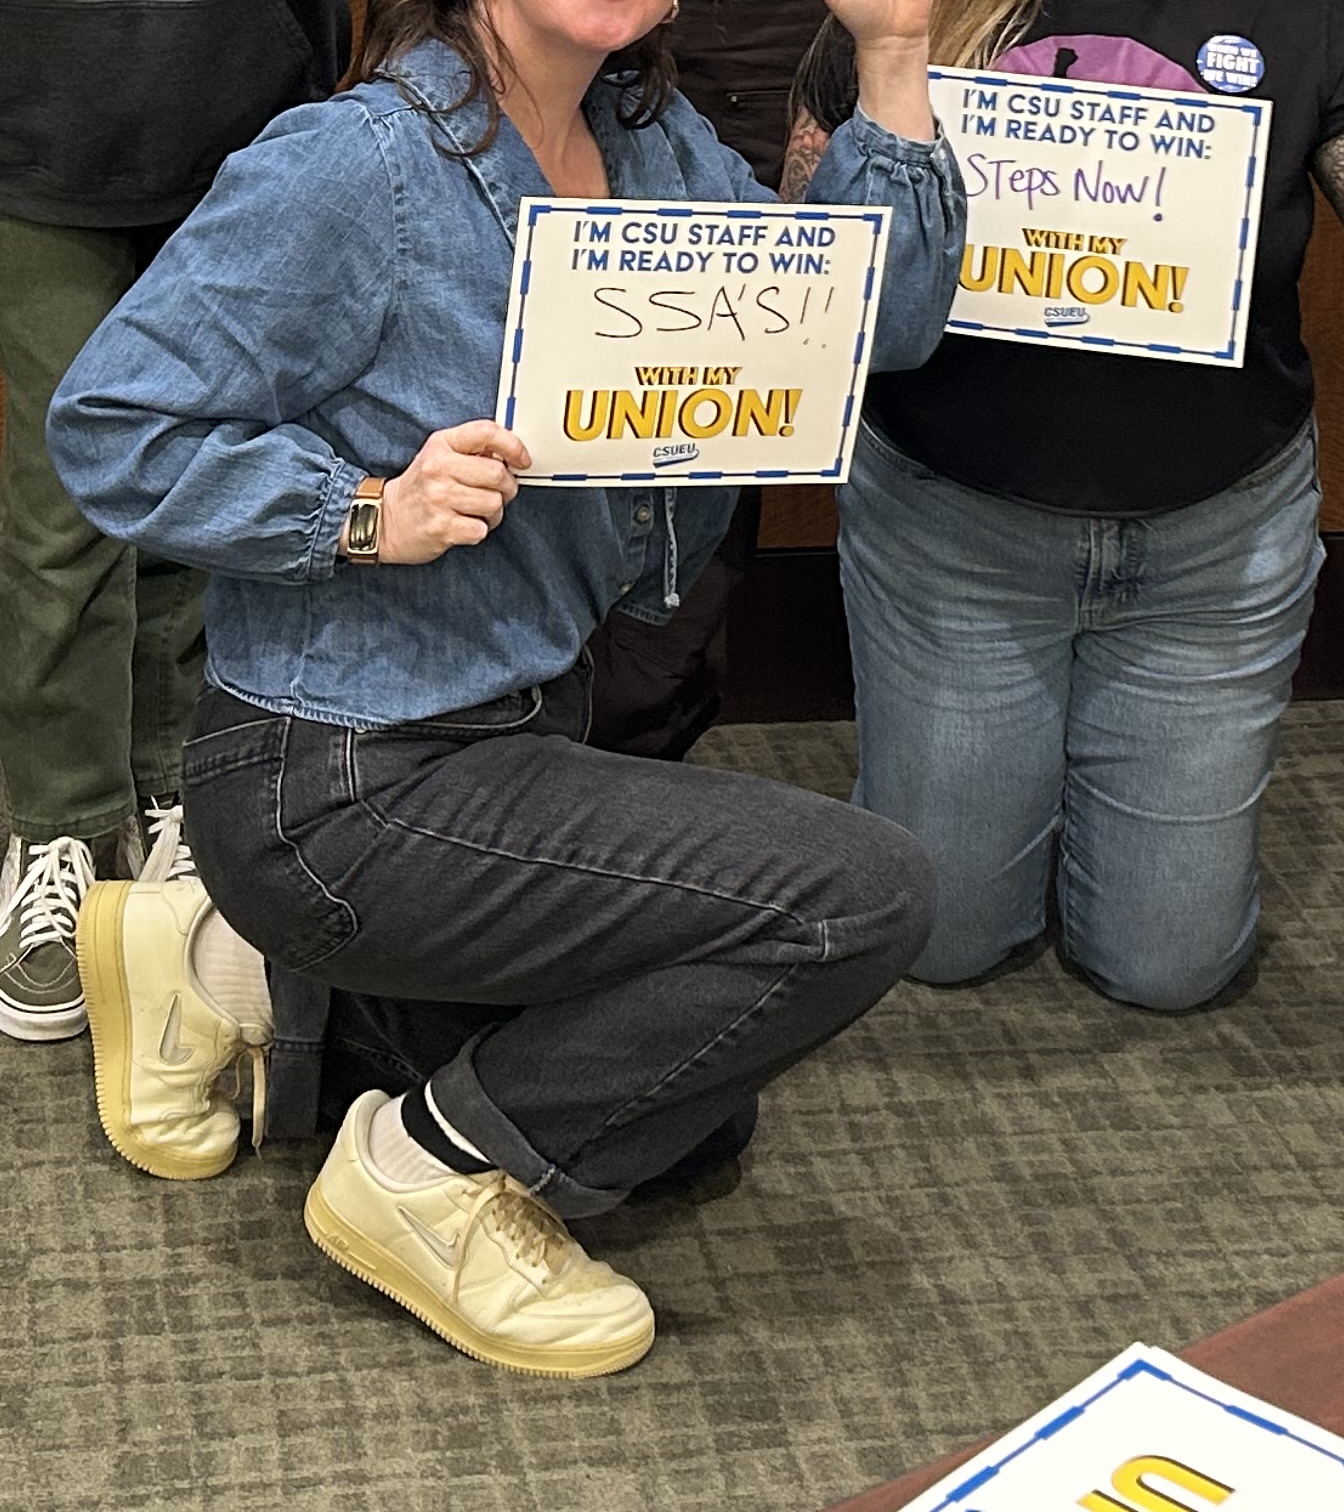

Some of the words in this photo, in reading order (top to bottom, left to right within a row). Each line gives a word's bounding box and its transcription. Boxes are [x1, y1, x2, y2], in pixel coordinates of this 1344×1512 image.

[1206, 51, 1260, 74] FIGHT
[963, 89, 997, 112] I'M
[1008, 94, 1061, 117] CSU
[1070, 100, 1148, 125] STAFF
[1152, 111, 1215, 133] AND
[961, 114, 996, 137] I'M
[1006, 120, 1096, 146] READY
[1104, 129, 1139, 151] TO
[1150, 134, 1211, 159] WIN:
[574, 220, 611, 243] I'M
[621, 221, 678, 244] CSU
[687, 223, 768, 247] STAFF
[775, 226, 835, 248] AND
[1022, 228, 1084, 253] WITH
[1088, 237, 1128, 255] MY
[571, 249, 610, 271] I'M
[619, 250, 714, 273] READY
[723, 252, 759, 274] TO
[769, 253, 831, 275] WIN:
[960, 244, 1190, 313] UNION!
[594, 284, 835, 349] SSA'S!!
[635, 366, 699, 385] WITH
[703, 366, 743, 385] MY
[563, 388, 803, 441] UNION!
